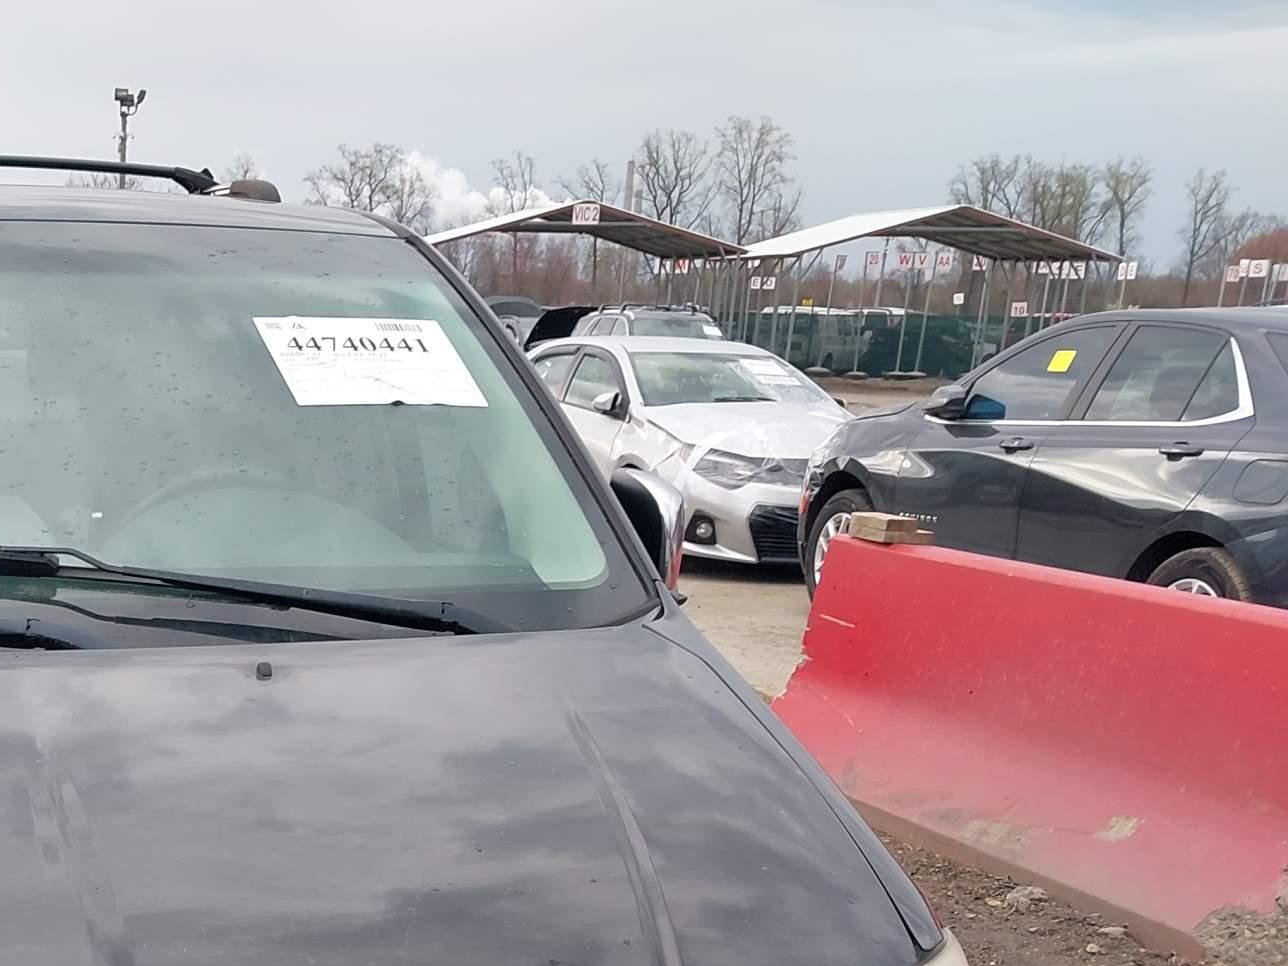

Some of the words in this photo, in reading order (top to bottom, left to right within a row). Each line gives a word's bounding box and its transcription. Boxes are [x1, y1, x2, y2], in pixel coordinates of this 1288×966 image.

[574, 206, 591, 222] VIC
[591, 206, 599, 222] 2
[899, 255, 911, 265] W
[919, 255, 928, 265] V
[938, 256, 951, 266] AA
[1253, 263, 1263, 274] S
[752, 278, 759, 287] E
[1014, 306, 1025, 315] 10
[287, 336, 431, 353] 44740441
